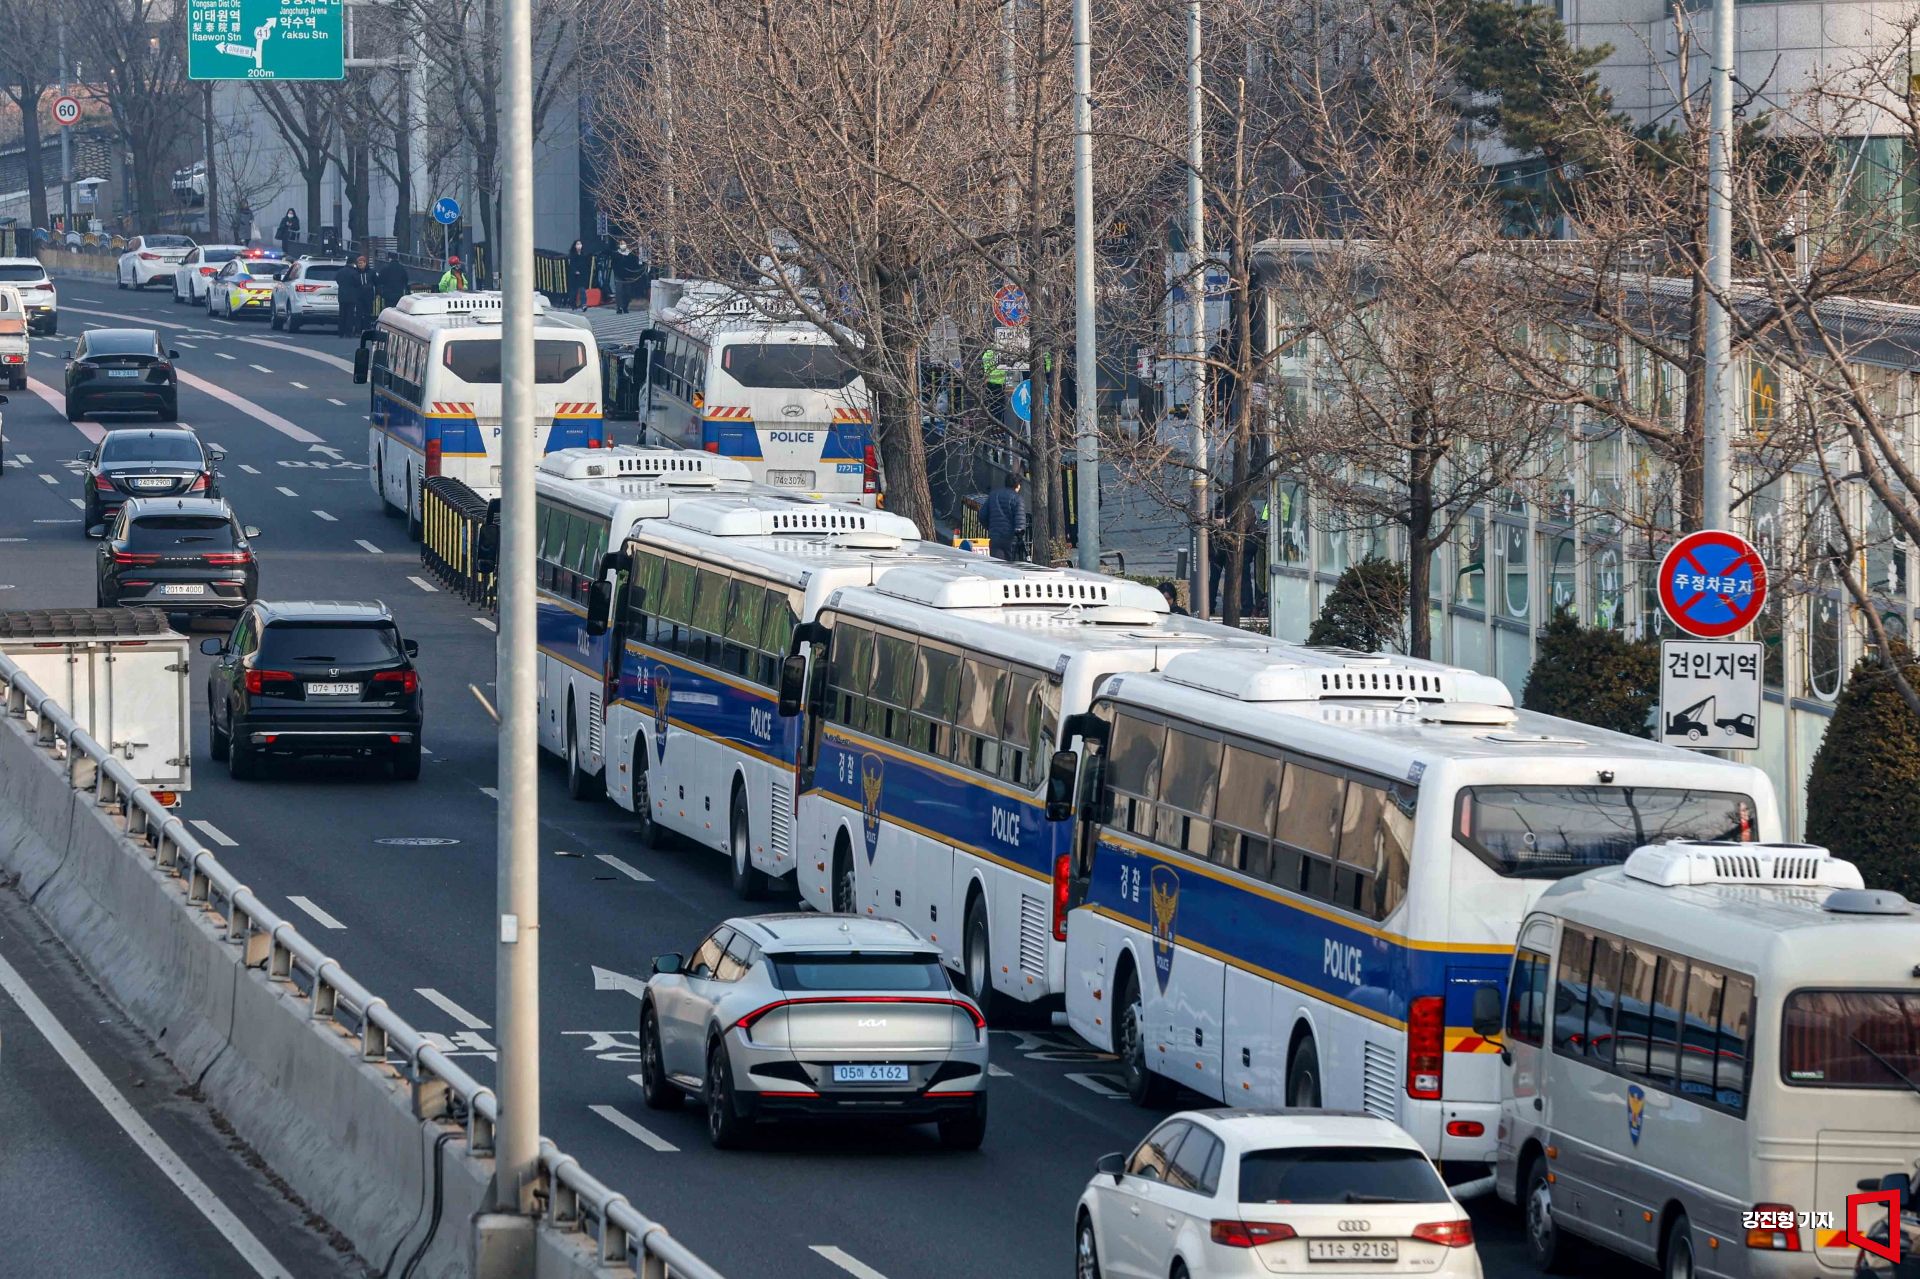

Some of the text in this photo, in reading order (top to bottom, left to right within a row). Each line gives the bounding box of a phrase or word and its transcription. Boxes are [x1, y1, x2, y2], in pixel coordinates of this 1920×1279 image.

[192, 0, 217, 9] Yongsan
[192, 10, 240, 22] 이태원역
[280, 6, 328, 16] Jangchung Arena
[280, 16, 316, 28] 약수역
[192, 32, 242, 41] Itaewon Stn
[256, 28, 268, 38] 41
[312, 31, 328, 39] Stn
[248, 69, 274, 78] 200m
[58, 105, 75, 116] 60
[770, 431, 814, 443] POLICE
[186, 586, 202, 594] 4000
[1674, 574, 1752, 595] 주정차금지
[1668, 652, 1757, 680] 견인지역
[334, 684, 354, 692] 1731
[750, 706, 772, 741] POLICE
[838, 752, 854, 785] 경찰
[991, 805, 1020, 847] POLICE
[1120, 864, 1140, 903] 경찰
[1156, 955, 1169, 972] POLICE
[1323, 937, 1362, 986] POLICE
[870, 1067, 902, 1079] 6162
[1318, 1242, 1390, 1257] 11수 9218
